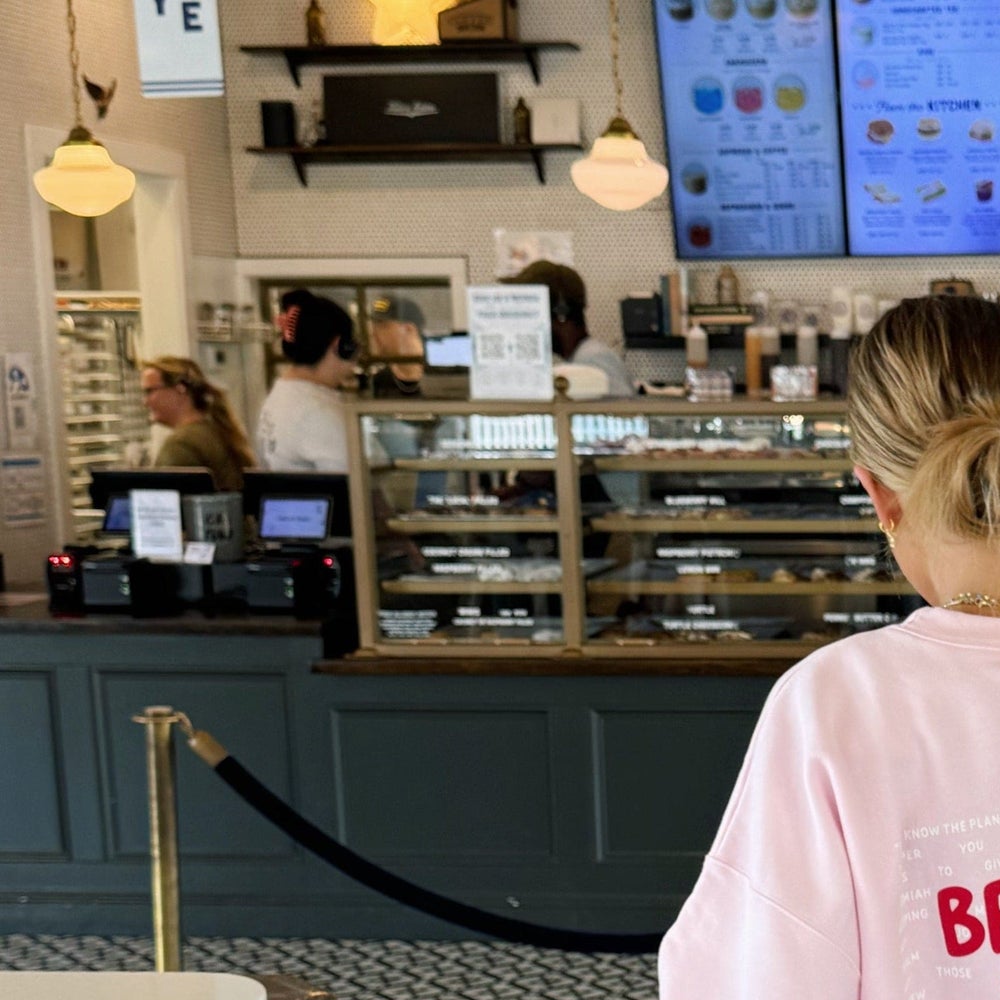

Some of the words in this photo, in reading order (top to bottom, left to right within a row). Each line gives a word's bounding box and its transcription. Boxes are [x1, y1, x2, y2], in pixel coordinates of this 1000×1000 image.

[943, 819, 967, 835] THE
[958, 840, 984, 855] YOU
[938, 865, 953, 878] TO
[935, 965, 973, 980] THOSE
